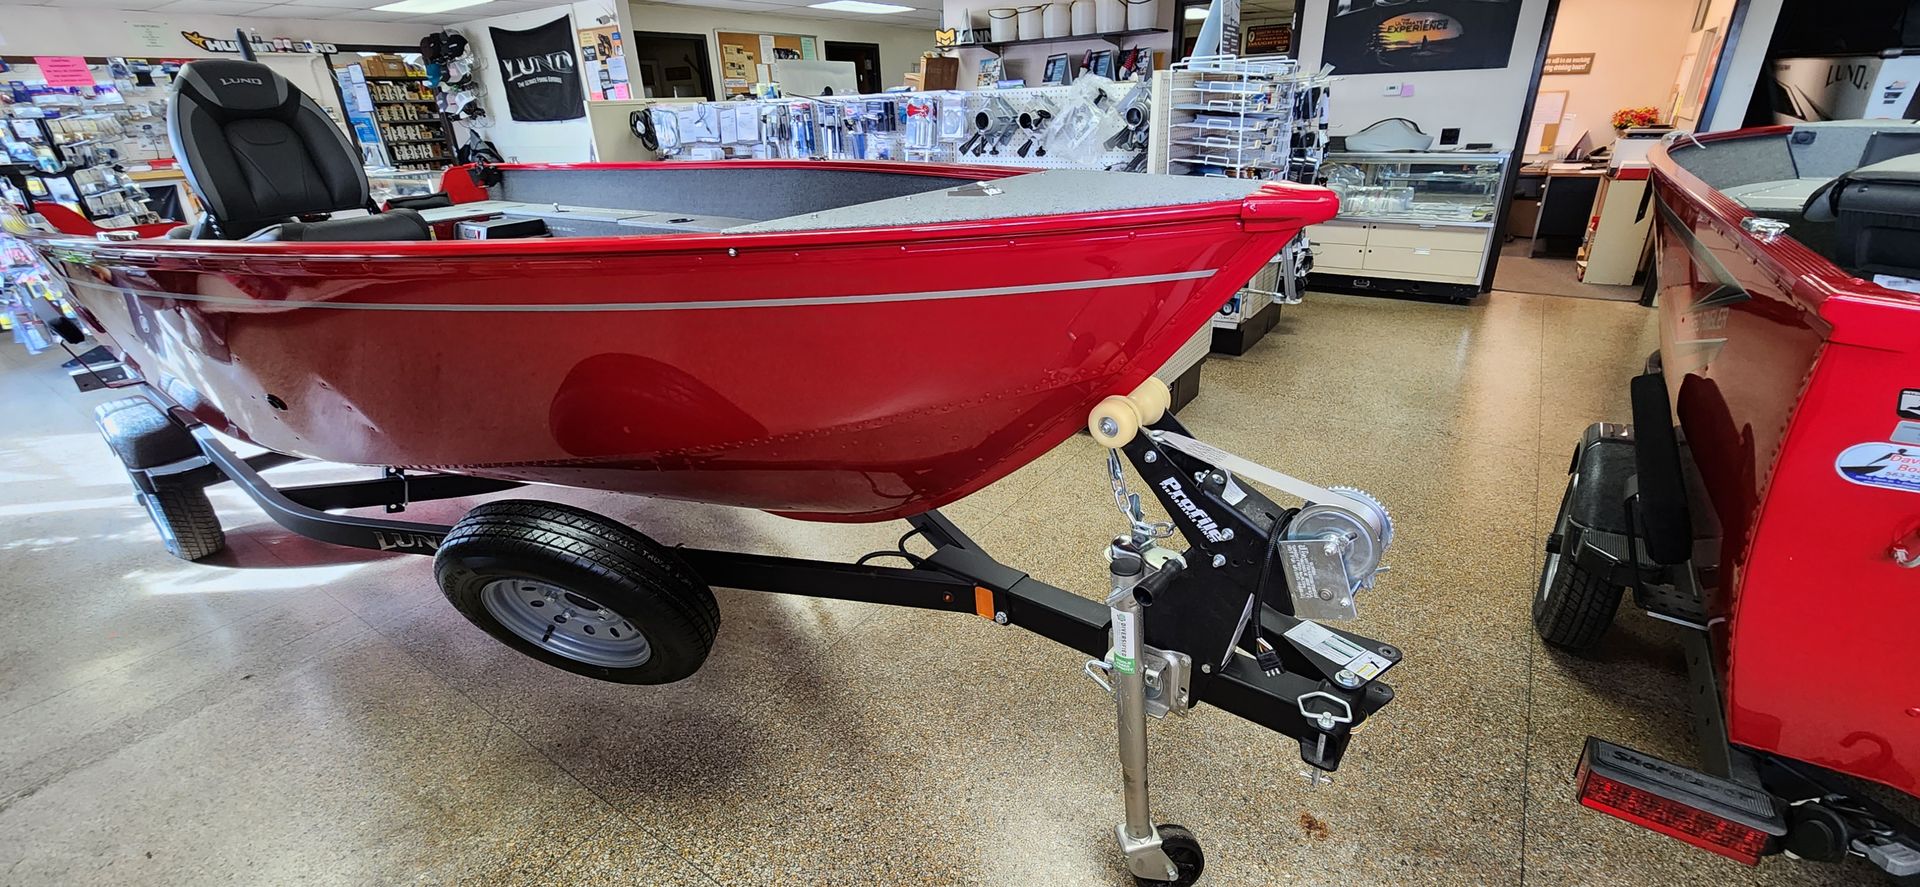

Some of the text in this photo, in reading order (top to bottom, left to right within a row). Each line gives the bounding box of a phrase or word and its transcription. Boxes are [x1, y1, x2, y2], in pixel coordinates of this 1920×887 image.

[1387, 22, 1449, 33] EXPERIENCE
[502, 51, 573, 81] LUND
[220, 77, 263, 86] LUND
[1890, 453, 1920, 465] Dav
[1159, 482, 1198, 523] PERFORMANCE
[1160, 477, 1222, 542] Profile
[373, 531, 442, 551] LUN
